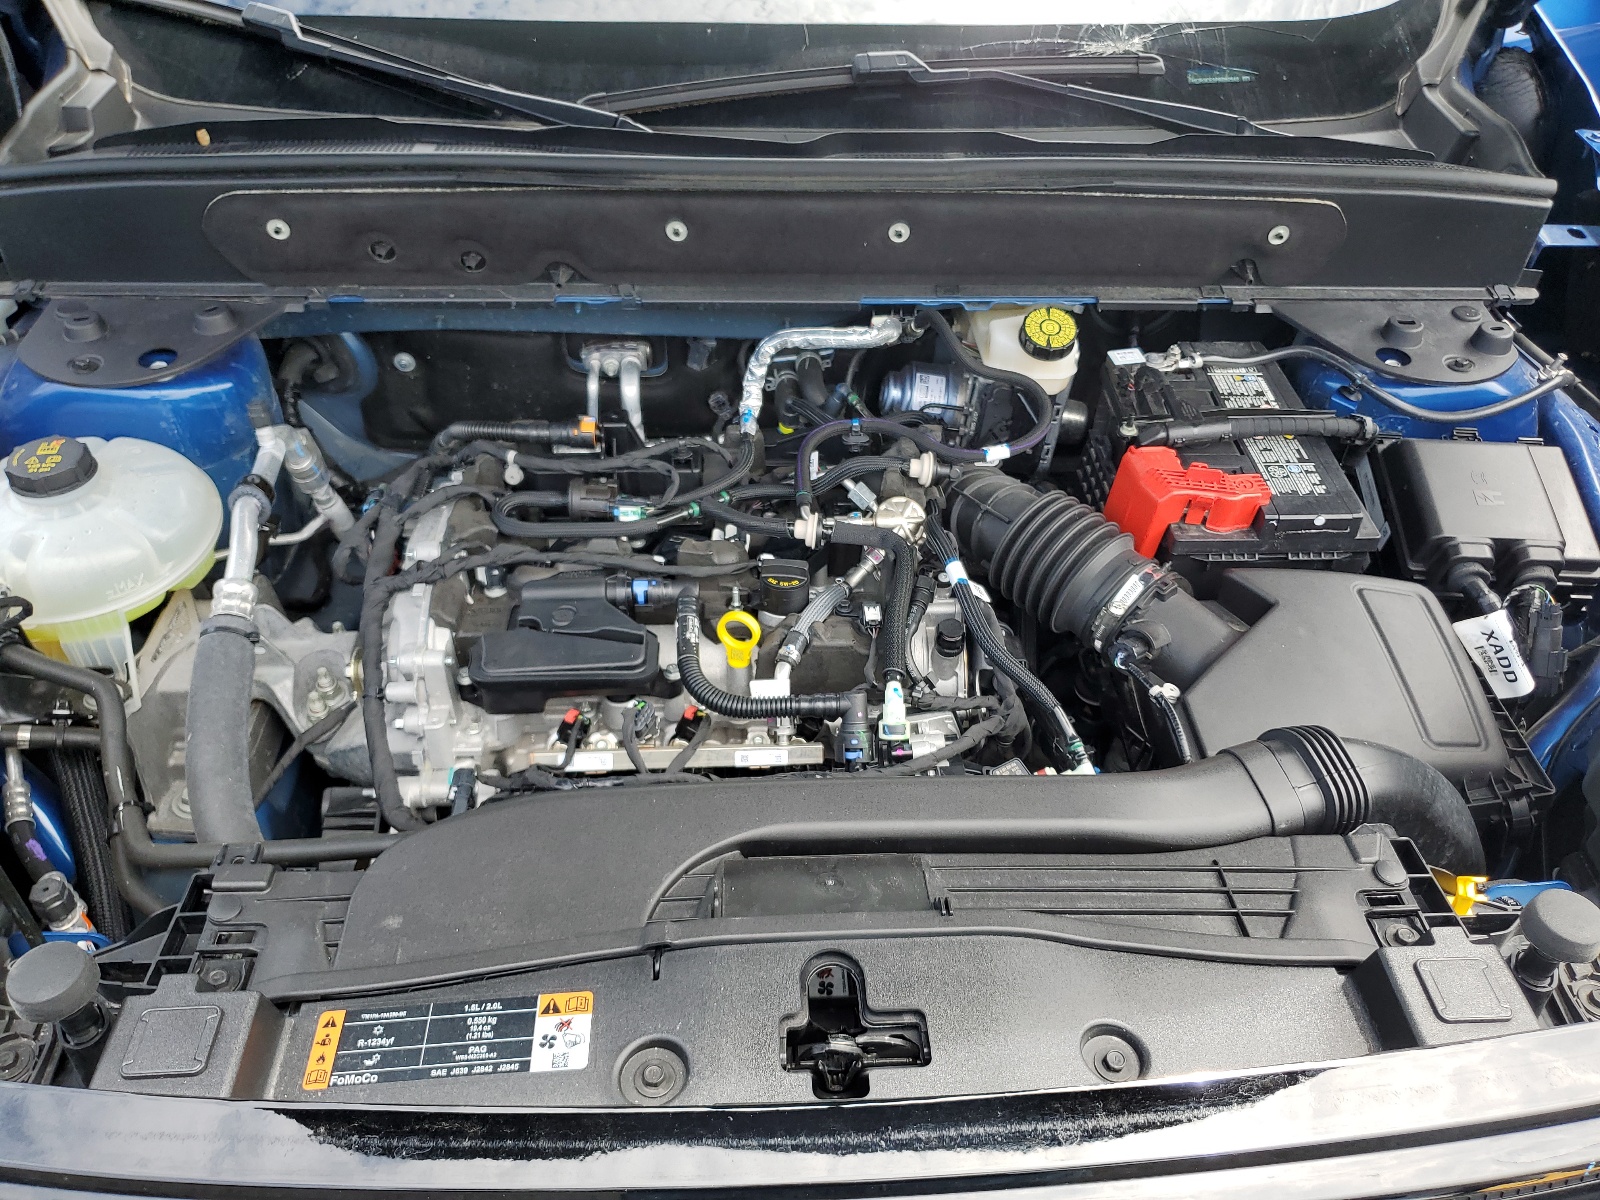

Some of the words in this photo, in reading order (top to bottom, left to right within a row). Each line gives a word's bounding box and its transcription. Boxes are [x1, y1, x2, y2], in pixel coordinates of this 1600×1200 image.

[1480, 629, 1518, 683] XADD
[485, 1001, 503, 1010] 2.0L
[487, 1015, 498, 1025] kg
[357, 1036, 395, 1048] R-1234yf
[468, 1045, 488, 1054] PAG
[430, 1068, 448, 1077] SAE
[329, 1073, 379, 1086] FoMoCo
